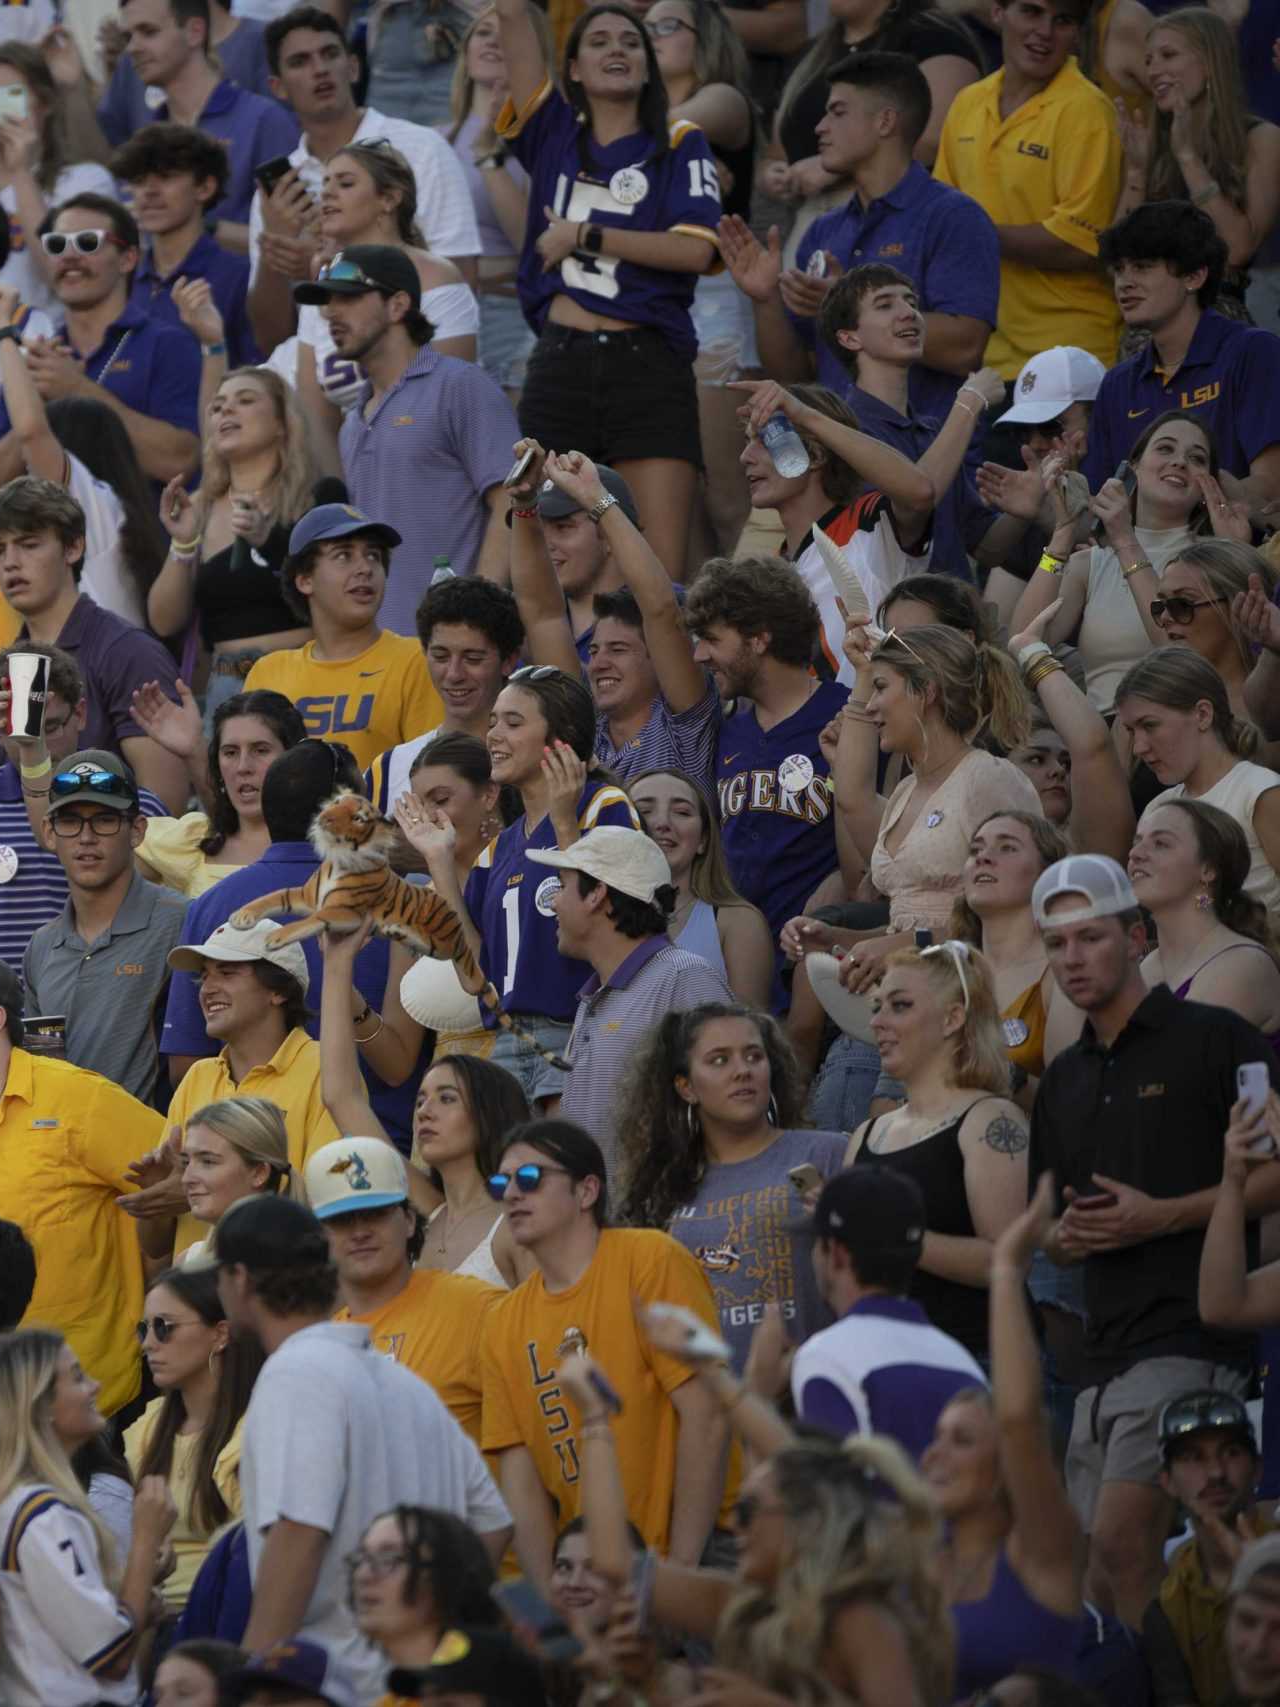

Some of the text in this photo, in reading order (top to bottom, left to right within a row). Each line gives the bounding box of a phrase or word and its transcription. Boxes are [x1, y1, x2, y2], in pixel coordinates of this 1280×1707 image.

[1017, 140, 1050, 161] LSU
[687, 158, 722, 202] 15
[1181, 381, 1221, 410] LSU
[297, 694, 376, 736] SU
[717, 767, 835, 826] IGERS
[502, 885, 521, 997] 1
[721, 1299, 797, 1328] IGES
[527, 1341, 581, 1485] LSU
[57, 1539, 86, 1578] 7
